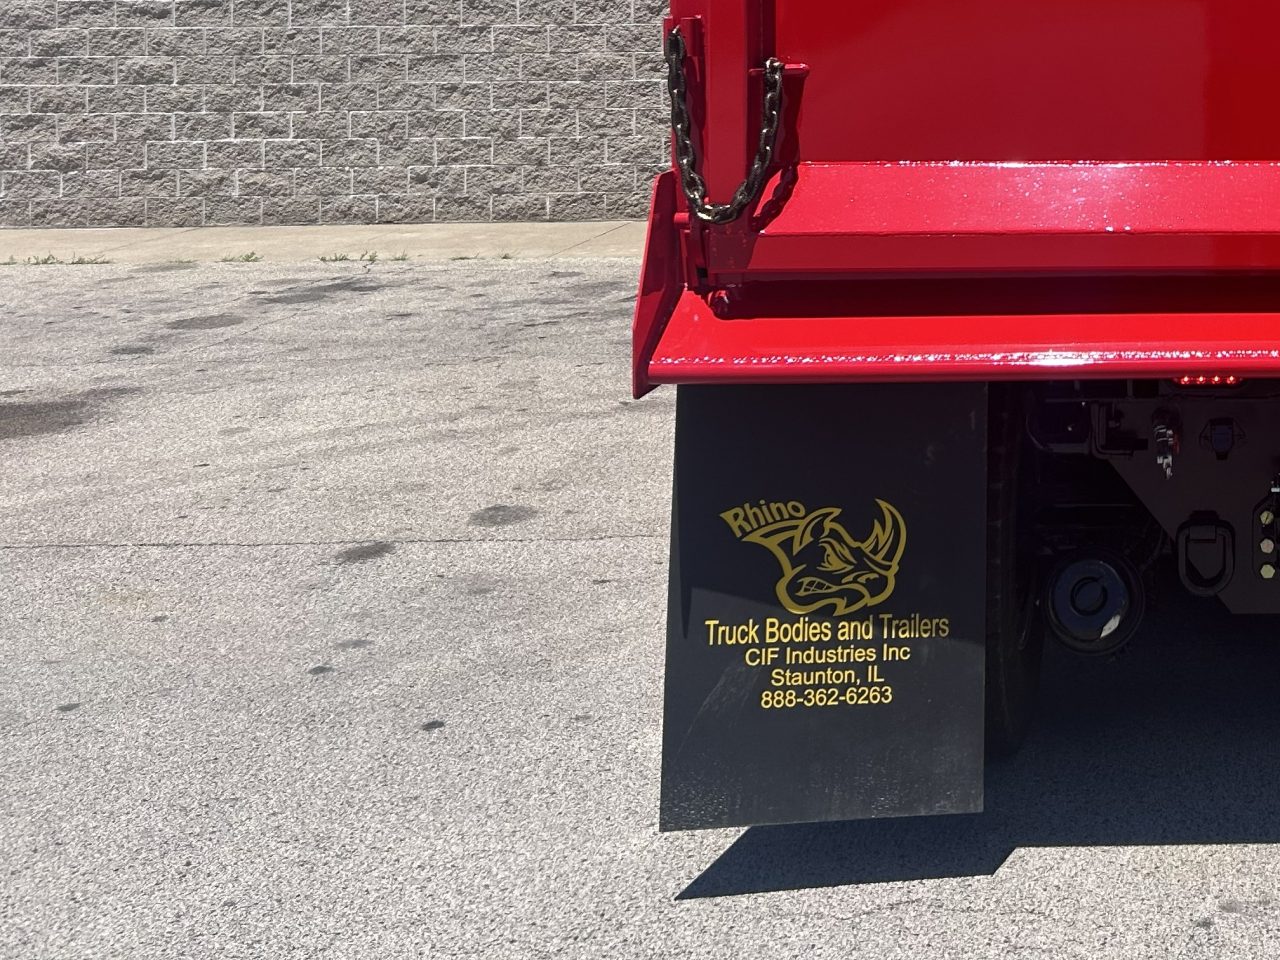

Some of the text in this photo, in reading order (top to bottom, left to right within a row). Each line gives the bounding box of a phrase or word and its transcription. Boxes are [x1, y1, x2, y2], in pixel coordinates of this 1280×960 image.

[719, 499, 806, 538] Rhino
[705, 613, 950, 645] Truck Bodies and Trailers
[744, 643, 912, 667] CIF Industries Inc
[770, 665, 885, 687] Staunton, IL
[760, 686, 893, 709] 888-362-6263
